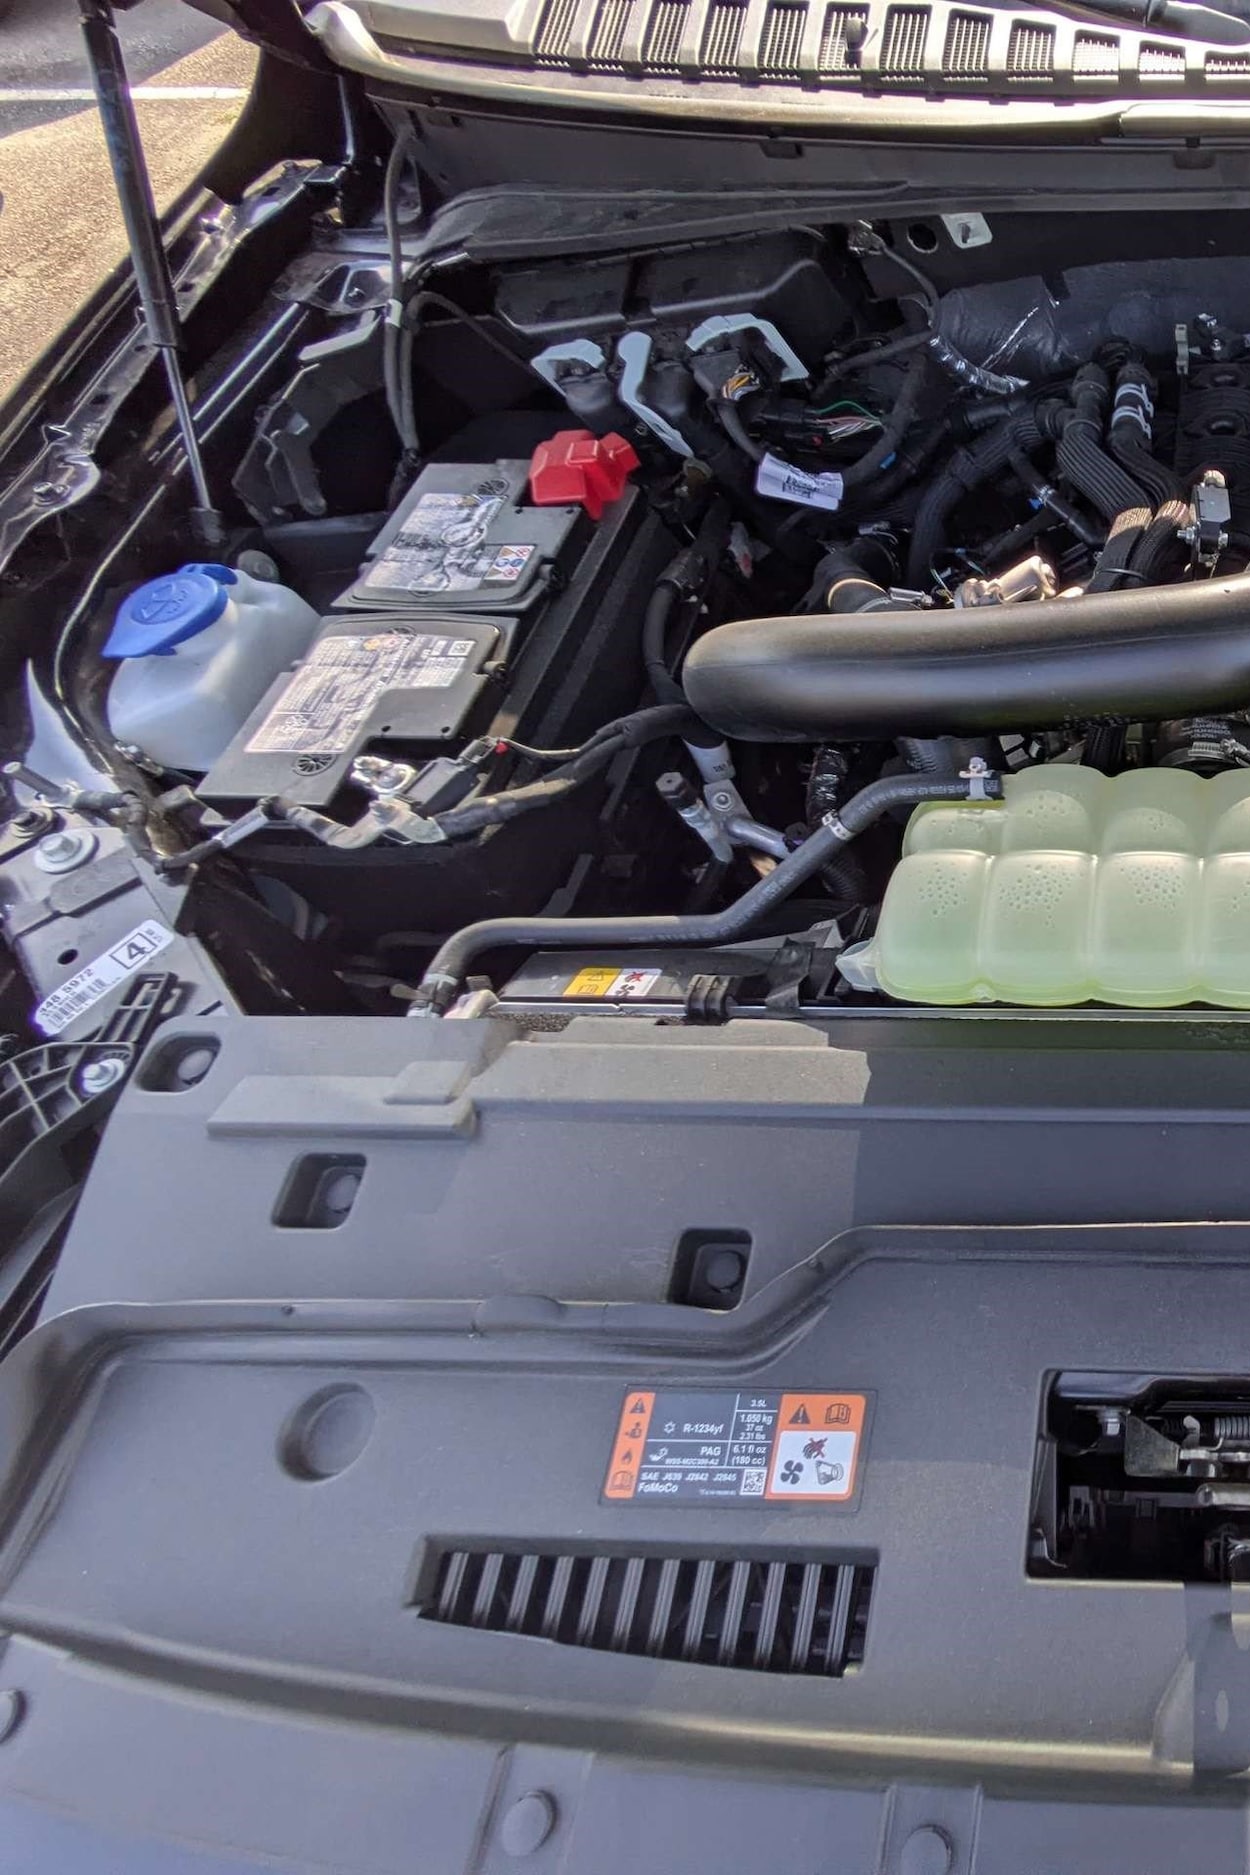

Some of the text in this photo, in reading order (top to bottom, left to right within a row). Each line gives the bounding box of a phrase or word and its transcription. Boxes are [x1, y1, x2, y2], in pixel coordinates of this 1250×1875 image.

[127, 942, 147, 959] 4
[761, 1414, 773, 1425] kg
[683, 1423, 724, 1435] R-1234yf
[700, 1446, 721, 1456] PAG
